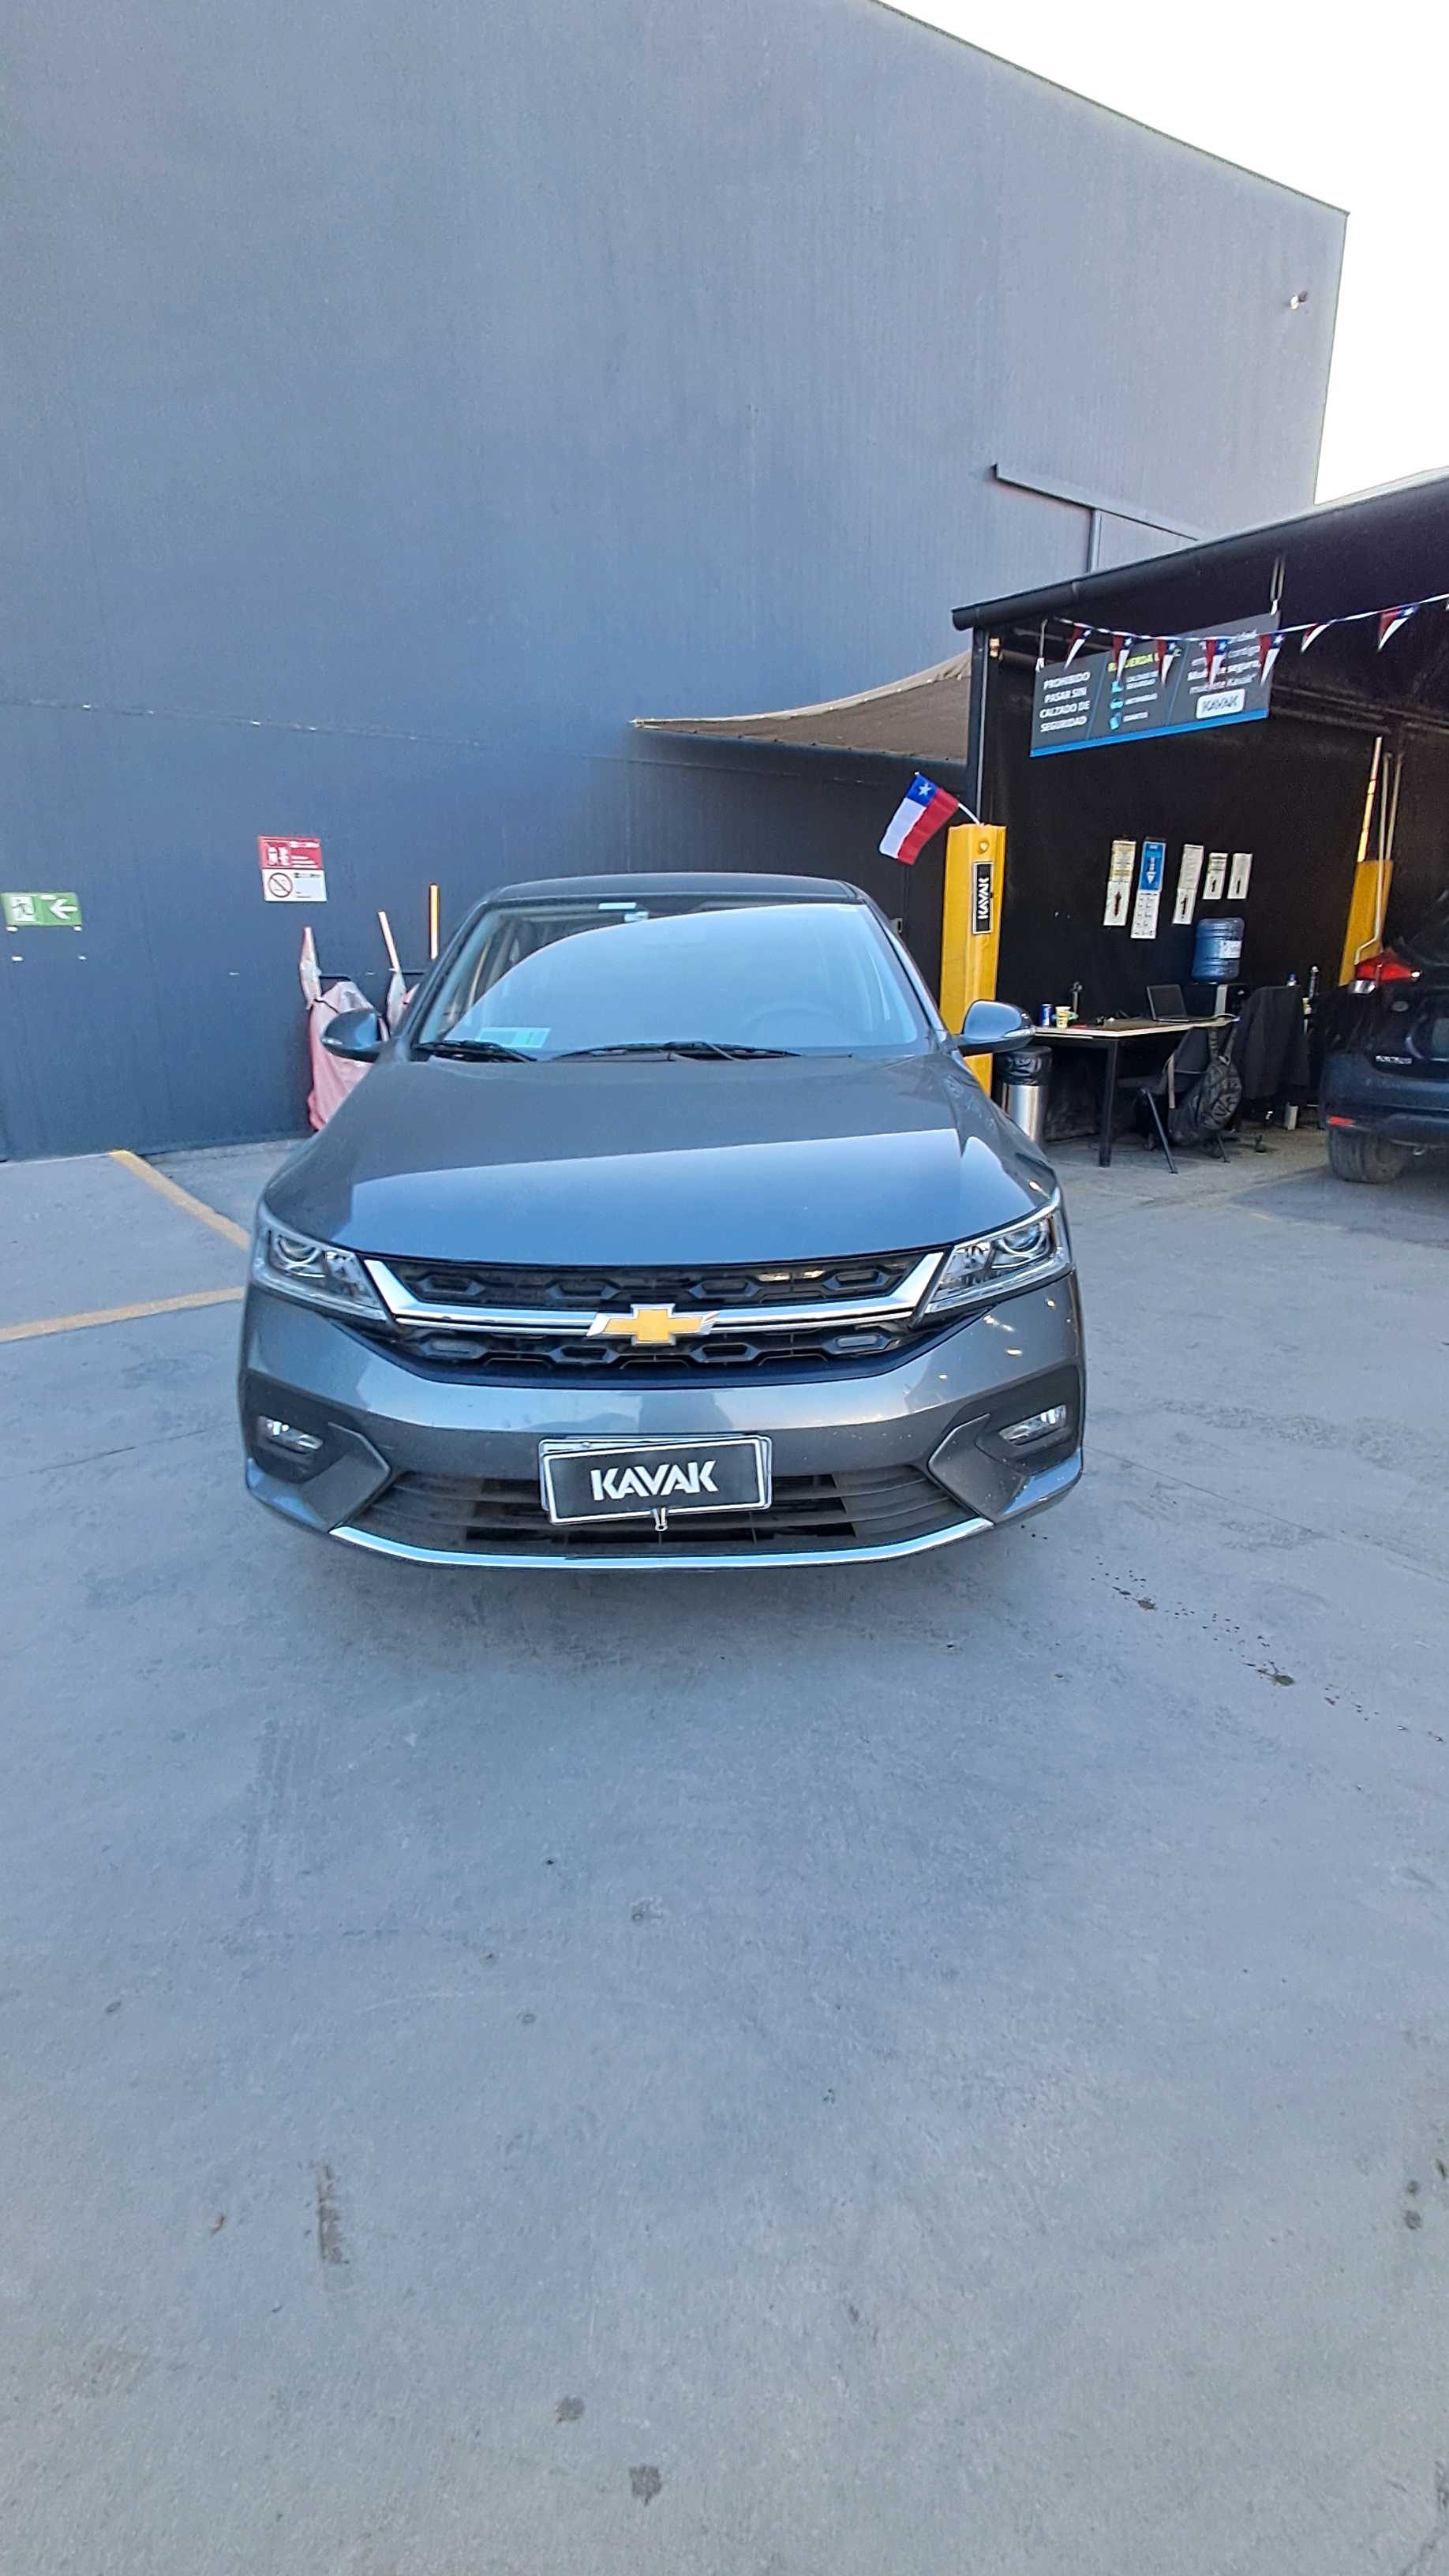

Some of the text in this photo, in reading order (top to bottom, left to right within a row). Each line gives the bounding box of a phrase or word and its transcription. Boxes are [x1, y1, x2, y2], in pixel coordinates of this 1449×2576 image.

[1043, 672, 1091, 690] PROHIBIDO
[1044, 691, 1071, 704] PASAR
[1039, 700, 1091, 718] CALZADO DE
[1040, 715, 1088, 732] SEGURIDAD
[978, 878, 989, 919] KAVAK
[590, 1459, 719, 1501] KAVAK
